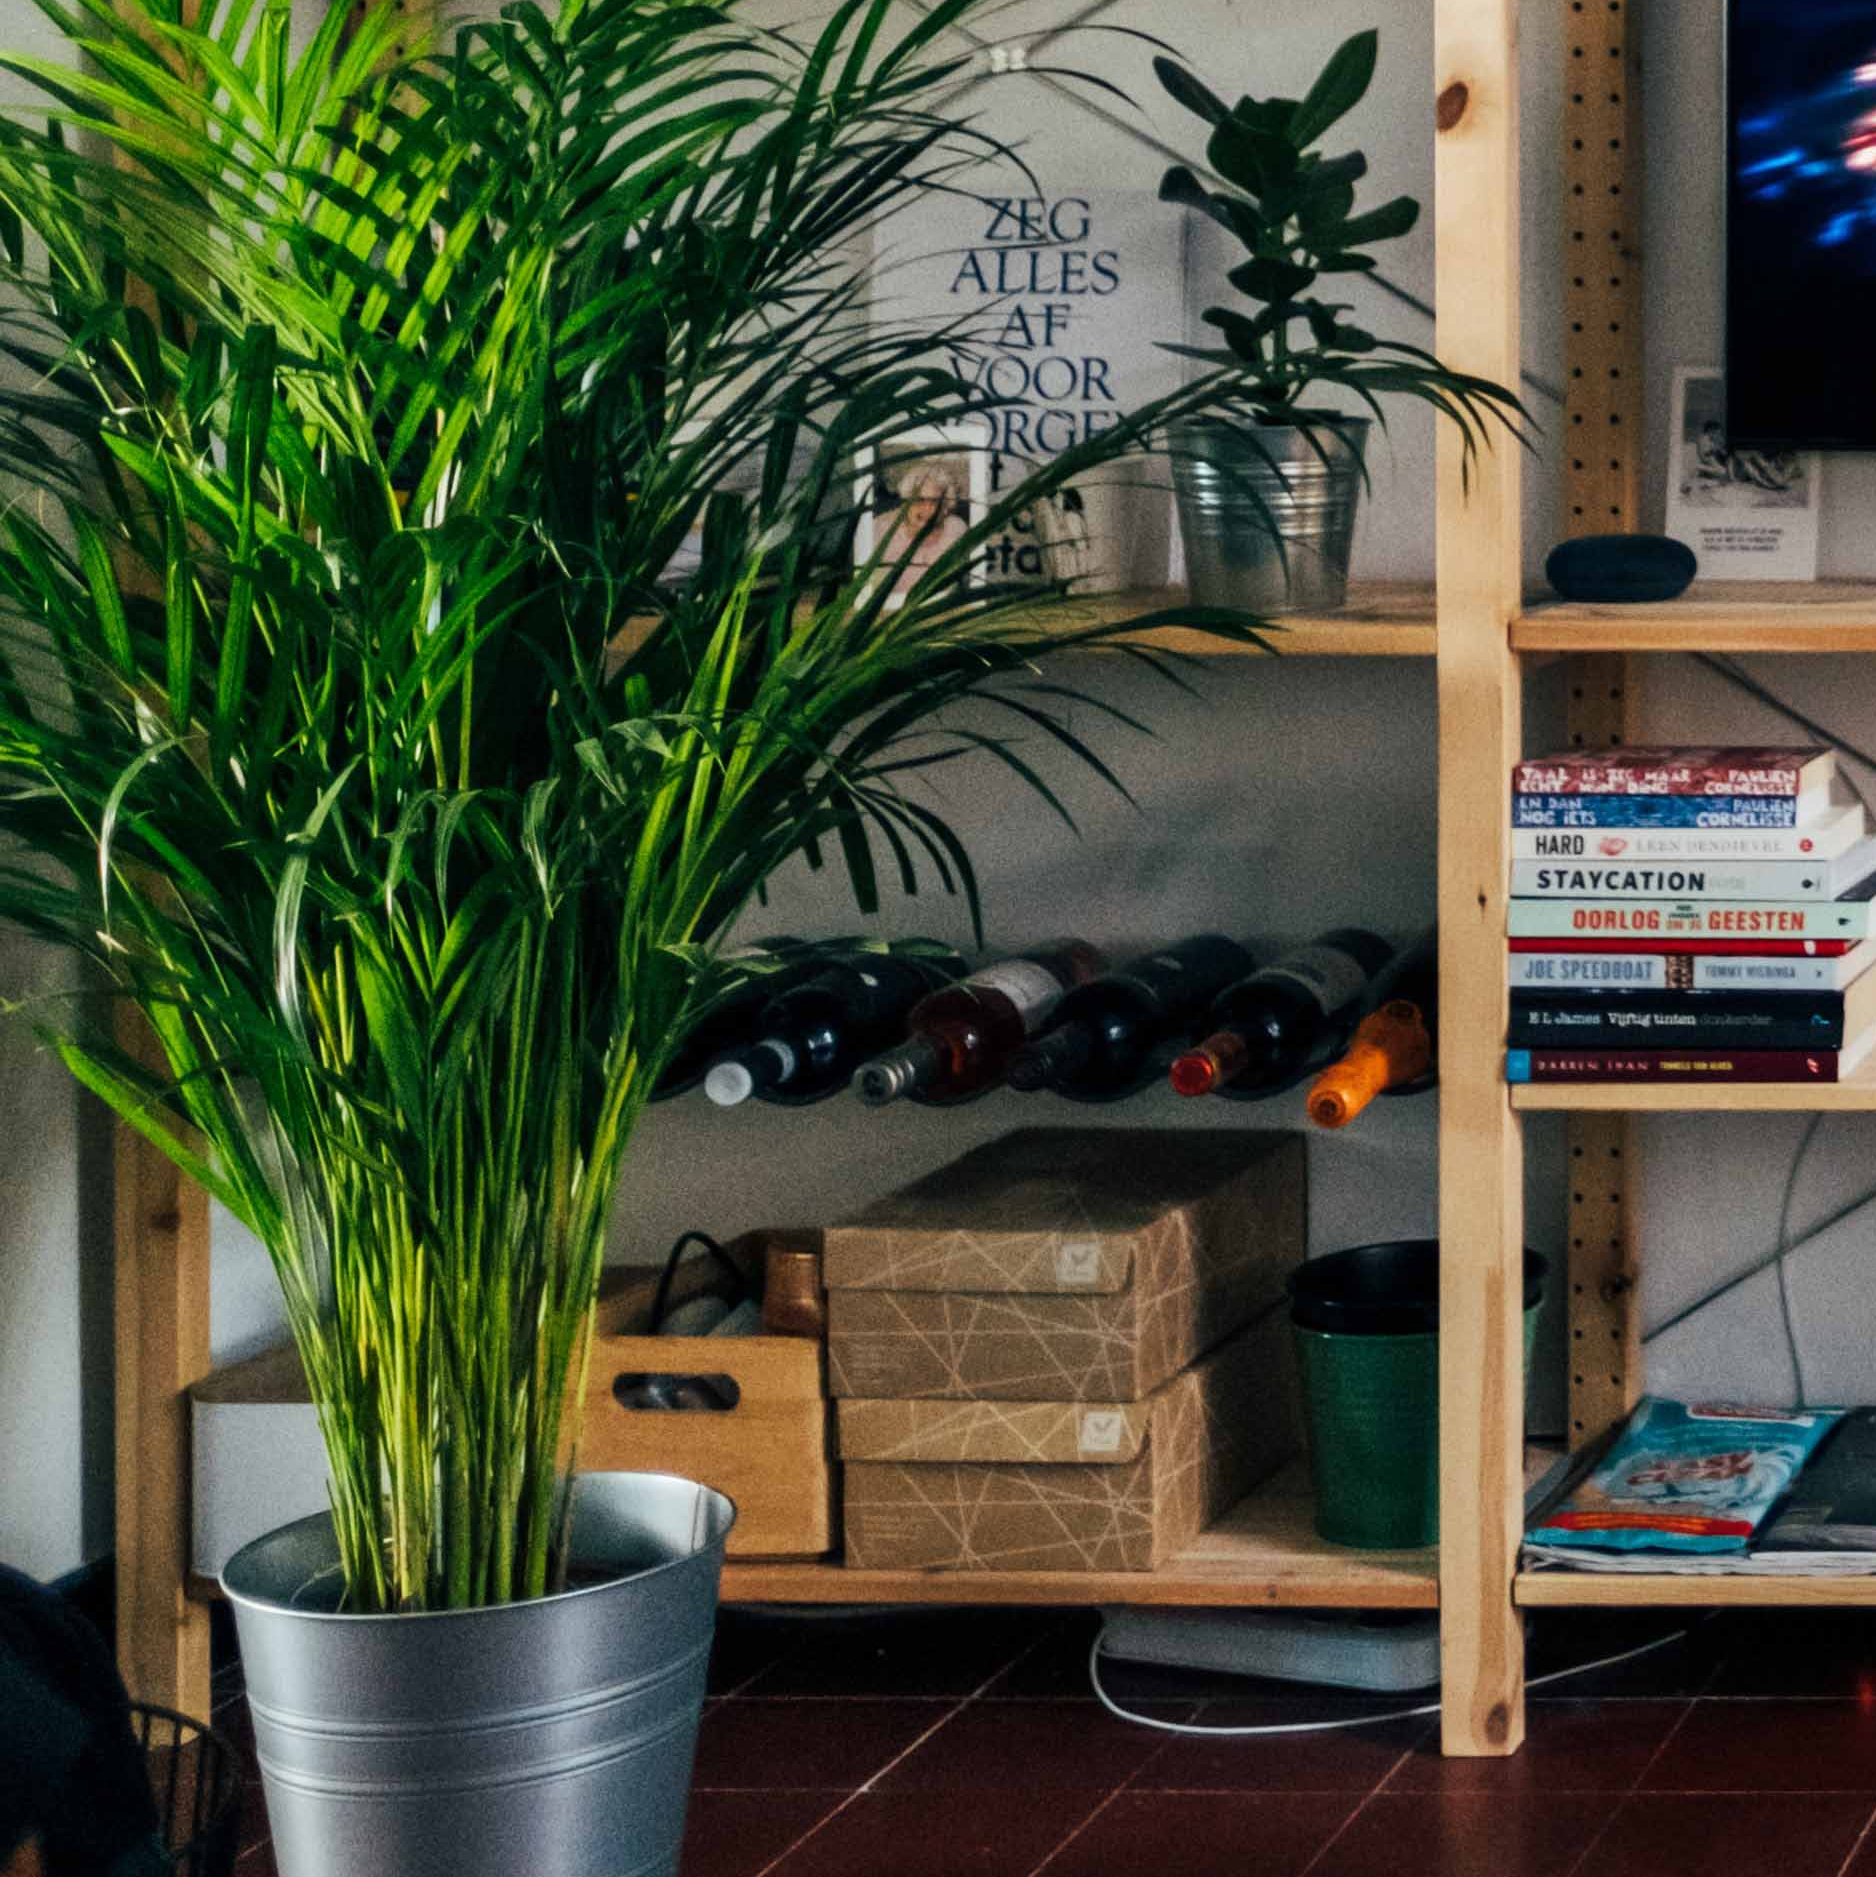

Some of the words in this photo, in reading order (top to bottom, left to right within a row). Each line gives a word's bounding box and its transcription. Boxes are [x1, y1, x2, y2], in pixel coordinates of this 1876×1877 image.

[983, 197, 1091, 242] ZEG
[949, 250, 1121, 296] ALLES
[998, 304, 1072, 350] AF
[948, 356, 1117, 401] VOOR
[1519, 768, 1568, 782] TAAL
[1643, 769, 1692, 782] MAAR
[1728, 769, 1797, 783] PAULIEN
[1519, 781, 1563, 793] ECHT
[1626, 781, 1669, 794] DING
[1703, 782, 1797, 795] CORNELISSE
[1519, 798, 1539, 810] EN
[1548, 797, 1582, 810] DAN
[1519, 811, 1556, 825] NOG
[1535, 834, 1585, 856] HARD
[1536, 869, 1706, 892] STAYCATION
[1572, 908, 1661, 931] OORLOG
[1707, 909, 1805, 932] GEESTEN
[1524, 960, 1557, 980] JOE
[1560, 959, 1655, 981] SPEEDBOAT
[1704, 964, 1743, 979] TOMMY
[1746, 964, 1797, 980] WIERINGA
[1529, 1011, 1539, 1024] E
[1541, 1011, 1552, 1024] L
[1554, 1011, 1601, 1025] James
[1607, 1010, 1651, 1028] Vijftig
[1653, 1011, 1697, 1026] tinten
